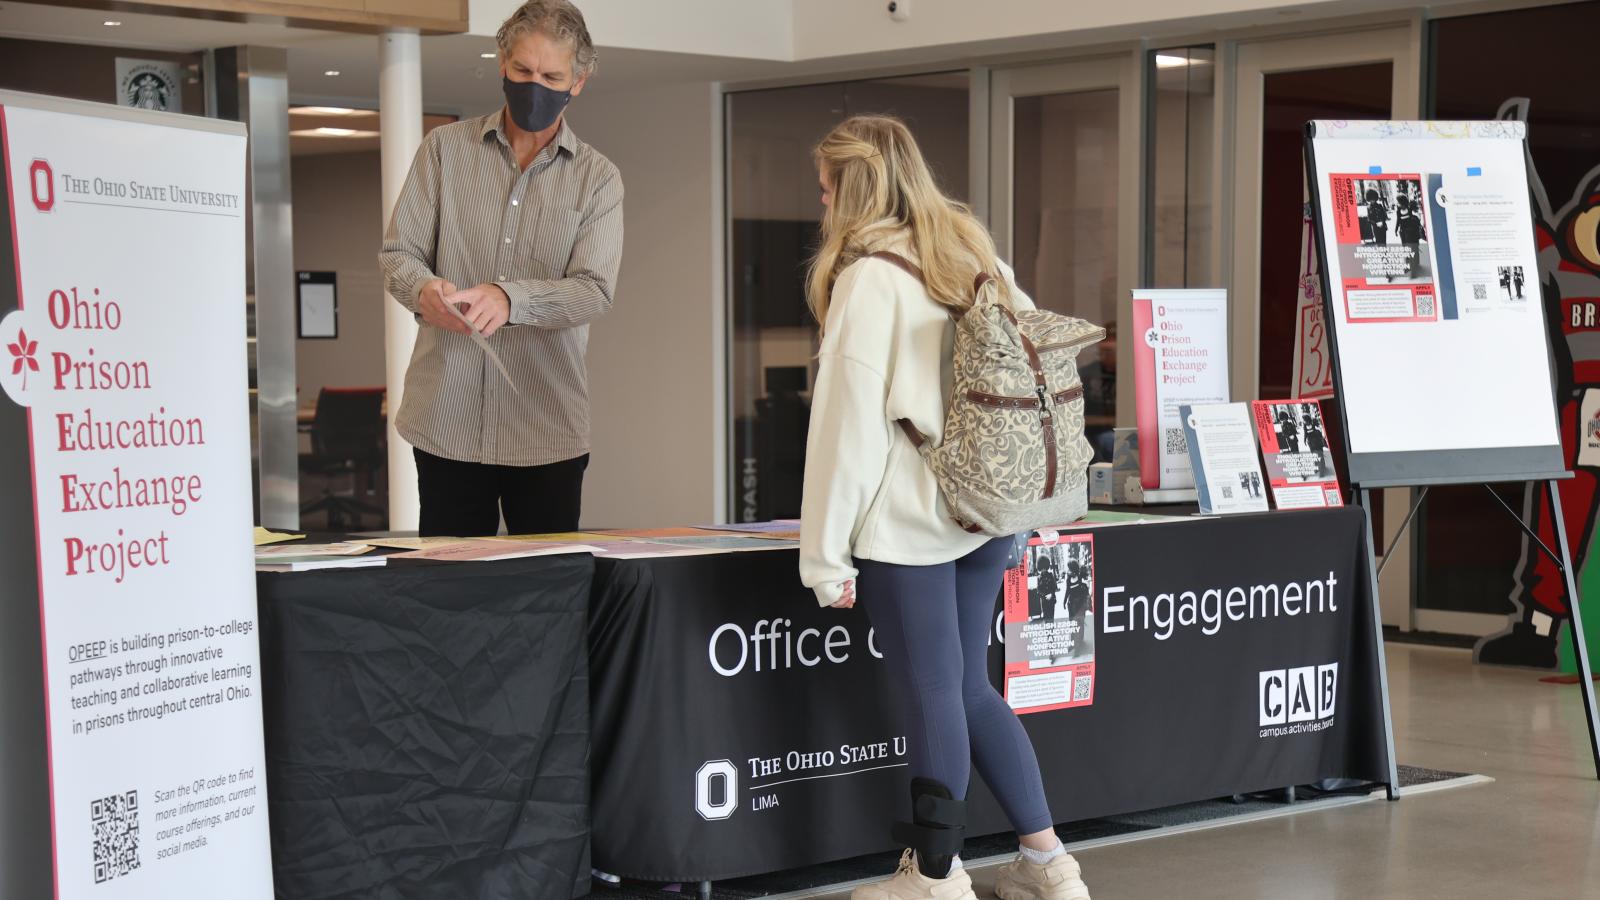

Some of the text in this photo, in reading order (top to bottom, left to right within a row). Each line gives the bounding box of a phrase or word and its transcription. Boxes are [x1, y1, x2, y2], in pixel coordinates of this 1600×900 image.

[62, 173, 239, 209] THE OHIO STATE UNIVERSITY
[48, 286, 121, 330] Ohio
[1160, 321, 1183, 331] Ohio
[1161, 333, 1191, 344] Prison
[1162, 347, 1208, 357] Education
[51, 348, 151, 390] Prison
[1163, 360, 1207, 373] Exchange
[1163, 374, 1196, 387] Project
[55, 406, 205, 451] Education
[59, 467, 202, 516] Exchange
[743, 458, 757, 522] RASH
[64, 528, 170, 583] Project
[68, 620, 253, 661] OPEEP is building prison-to-college
[709, 618, 851, 676] Office
[1103, 571, 1338, 640] Engagement
[1020, 626, 1080, 639] INTRODUCTORY
[1023, 622, 1057, 631] ENGLISH
[1032, 634, 1070, 644] CREATIVE
[1027, 640, 1075, 651] NONFICTION
[1034, 648, 1068, 657] WRITING
[70, 646, 223, 689] pathways through innovative
[71, 663, 252, 710] teaching and collaborative learning
[1261, 666, 1336, 722] CAB
[73, 685, 253, 735] in prisons throughout central Ohio.
[748, 757, 782, 778] THE
[786, 751, 834, 771] OHIO
[840, 742, 888, 765] STATE
[154, 767, 254, 804] Scan the QR code to find
[155, 785, 256, 822] more information, current
[752, 793, 779, 811] LIMA
[156, 804, 255, 841] course offerings, and our
[156, 834, 208, 860] social media.
